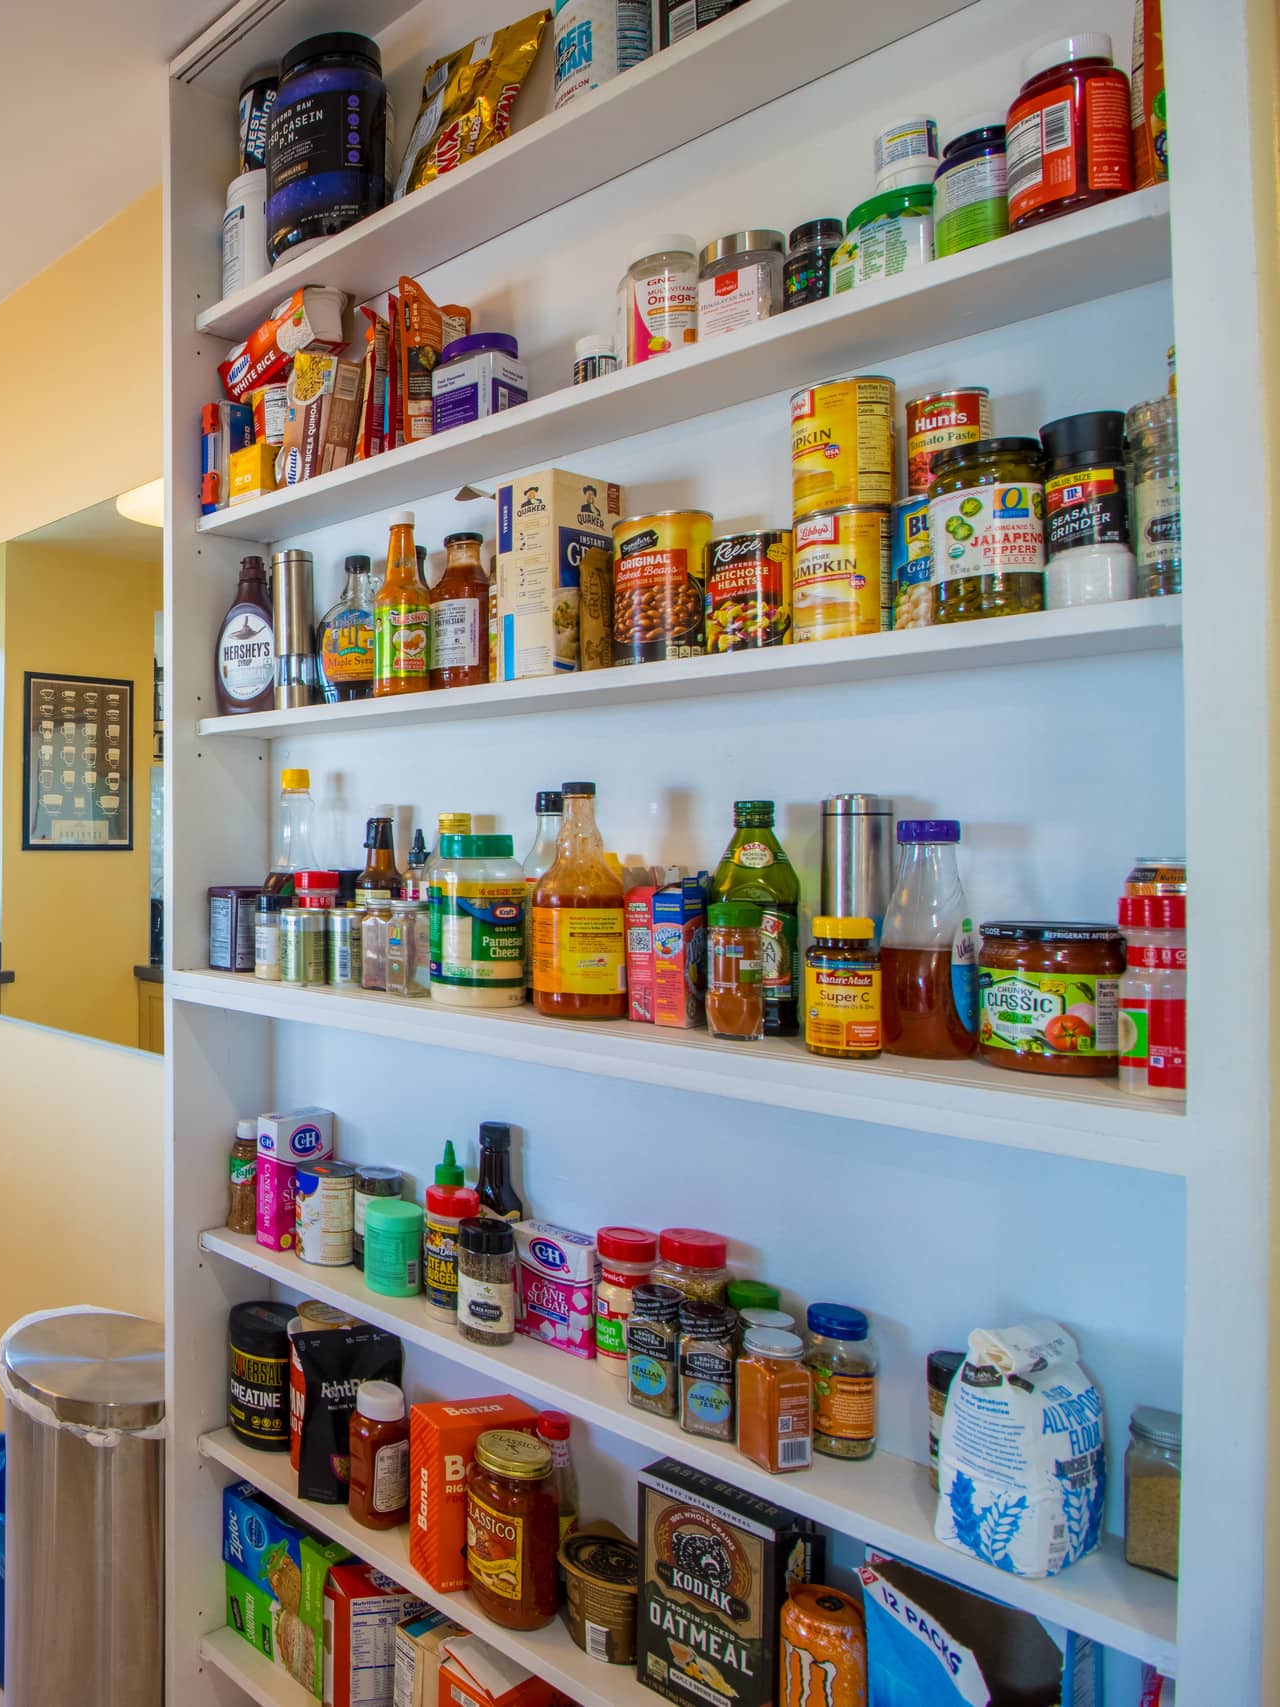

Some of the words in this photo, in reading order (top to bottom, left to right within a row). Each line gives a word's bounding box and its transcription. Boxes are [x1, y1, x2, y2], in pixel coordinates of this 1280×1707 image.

[247, 107, 262, 152] BEST
[254, 89, 277, 160] AMINOS
[646, 275, 677, 287] GNC
[228, 353, 251, 384] Minute
[232, 370, 258, 397] WHITE
[255, 350, 276, 374] RICE
[948, 431, 976, 441] Paste
[287, 447, 298, 485] Minute
[1073, 472, 1092, 482] SIZE
[516, 503, 546, 518] QUAKER
[577, 513, 605, 529] QUAKER
[1050, 512, 1111, 541] GRINDER
[800, 524, 829, 541] Libby's
[579, 535, 606, 549] INSTANT
[983, 545, 1037, 556] PEPPERS
[620, 553, 671, 571] ORIGINAL
[713, 539, 762, 567] Reese
[643, 565, 678, 577] Beans
[710, 567, 769, 583] ARTICHOKE
[795, 558, 857, 580] UMPKIN
[718, 578, 759, 590] HEARTS
[224, 641, 270, 662] HERSHEY'S
[354, 656, 374, 666] Syru
[499, 908, 515, 917] Kraft
[489, 947, 520, 958] Cheese
[818, 974, 848, 984] Nature
[848, 976, 872, 985] Made
[820, 989, 858, 1003] Super
[861, 992, 870, 1002] C
[997, 985, 1034, 997] CHUNKY
[987, 992, 1053, 1013] CLASSIC
[294, 1131, 317, 1149] C&H
[535, 1243, 561, 1265] C&H
[427, 1255, 455, 1273] STEAK
[427, 1267, 457, 1285] BURGER
[532, 1281, 567, 1301] CANE
[527, 1290, 569, 1315] SUGAR
[631, 1364, 662, 1379] ITALIAN
[712, 1375, 733, 1383] BLEND
[230, 1378, 281, 1408] CREATINE
[689, 1393, 730, 1406] JAMAICAN
[443, 1403, 504, 1417] Banza
[699, 1400, 721, 1410] JERK
[1042, 1403, 1069, 1435] ALL
[491, 1434, 542, 1451] CLASSICO
[663, 1462, 713, 1487] TASTE
[714, 1483, 779, 1517] BETTER
[418, 1467, 429, 1531] Banza
[468, 1501, 516, 1541] LASSICO
[229, 1508, 243, 1563] Ziploc
[684, 1511, 710, 1526] WHOLE
[711, 1523, 736, 1551] GRAINS
[671, 1567, 733, 1615] KODIAK
[666, 1600, 736, 1641] PROTEIN-PACKED
[649, 1600, 754, 1677] OATMEAL
[881, 1585, 900, 1614] 12
[904, 1604, 962, 1675] PACKS
